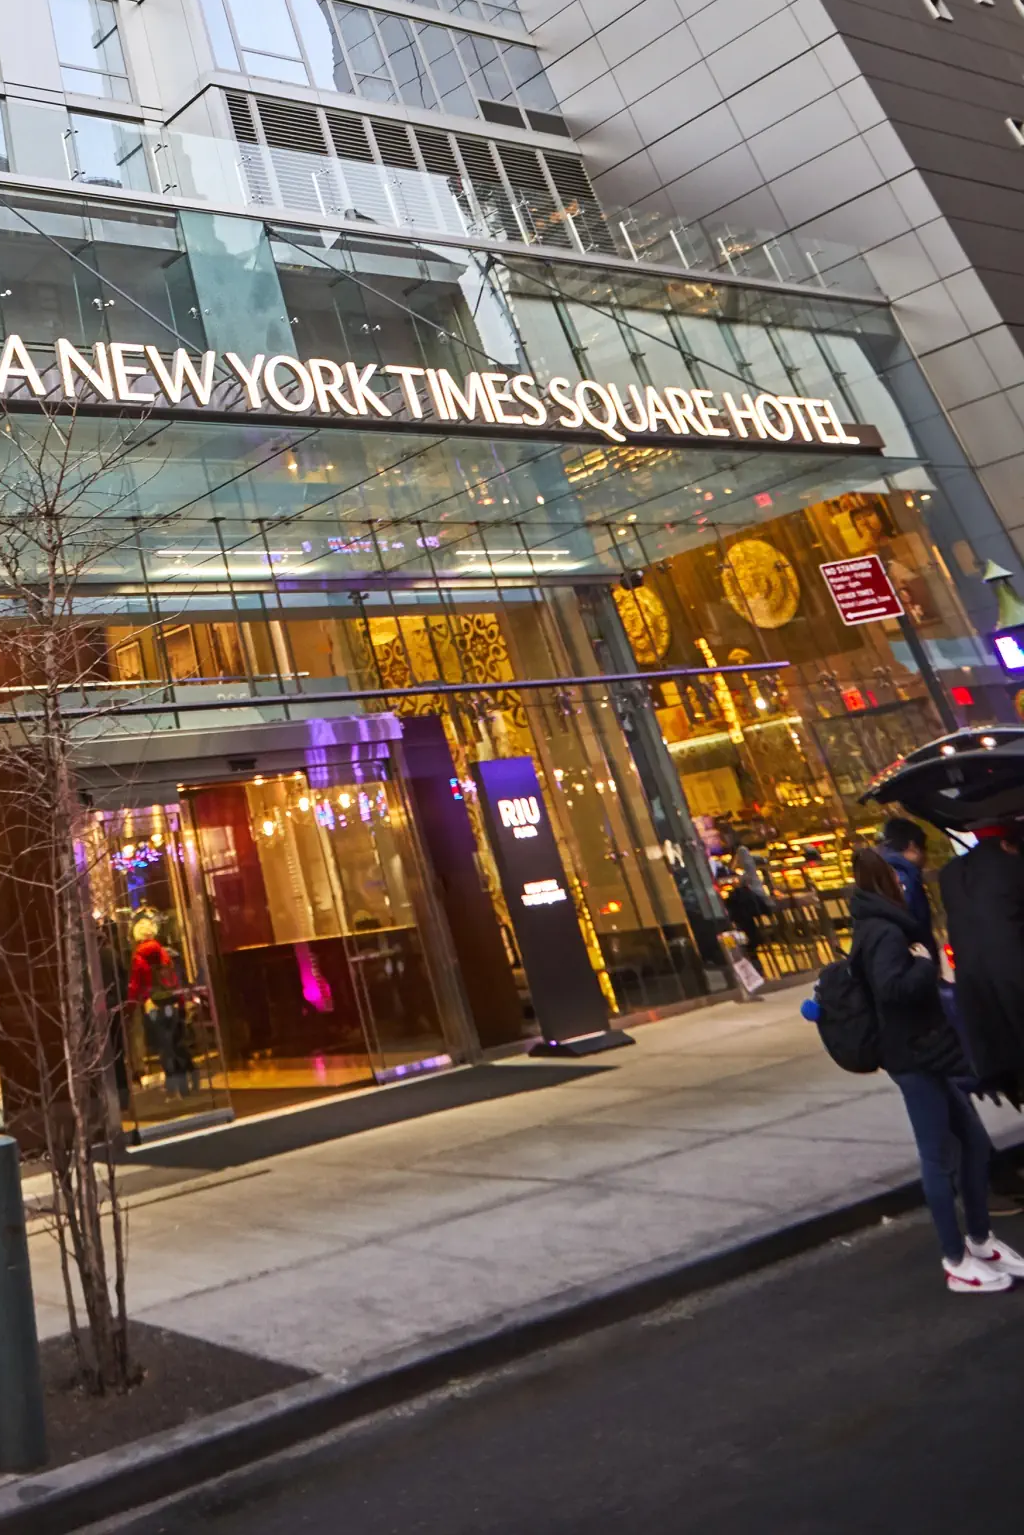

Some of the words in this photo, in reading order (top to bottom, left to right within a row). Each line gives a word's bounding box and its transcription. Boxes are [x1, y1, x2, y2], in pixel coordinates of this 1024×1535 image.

[54, 338, 216, 407] NEW
[221, 352, 393, 417] YORK
[379, 364, 547, 426] TIMES
[547, 377, 730, 442] SQUARE
[722, 391, 860, 445] HOTEL
[497, 796, 541, 828] RIU
